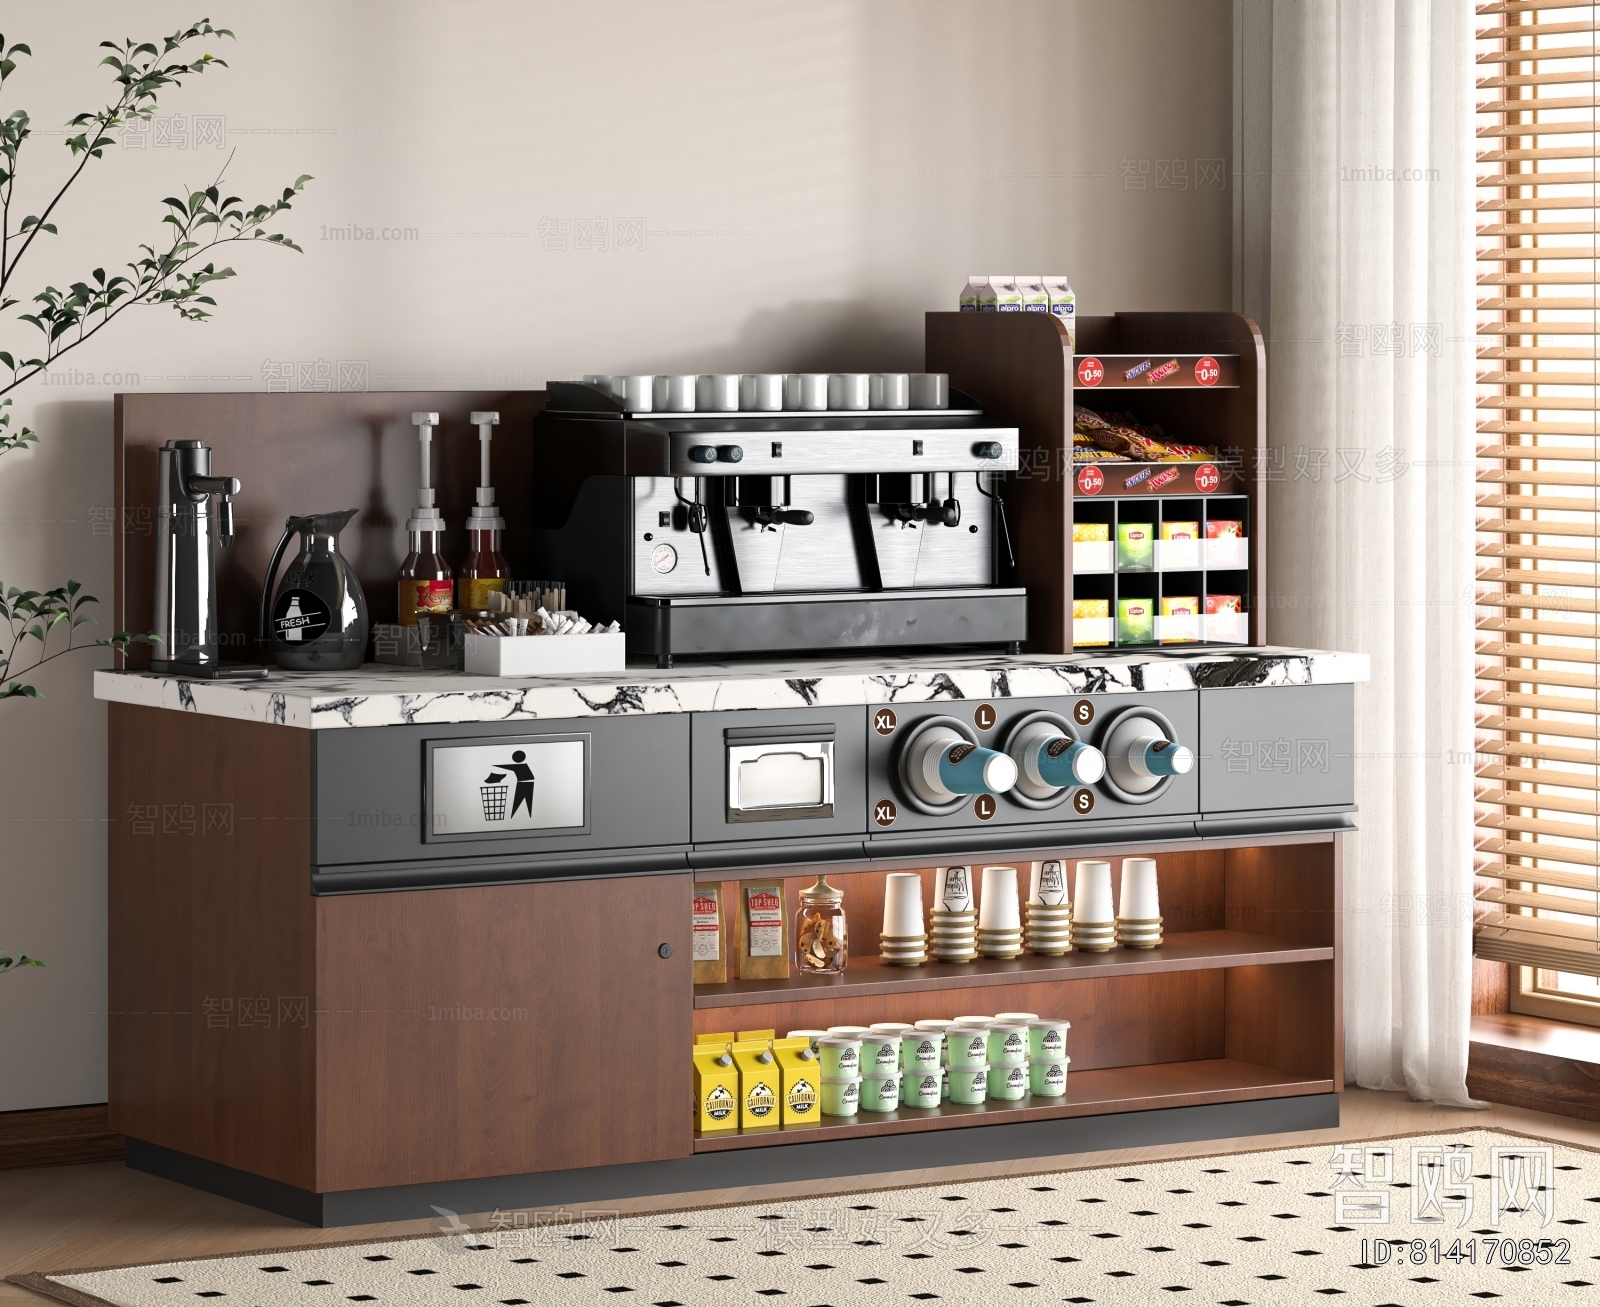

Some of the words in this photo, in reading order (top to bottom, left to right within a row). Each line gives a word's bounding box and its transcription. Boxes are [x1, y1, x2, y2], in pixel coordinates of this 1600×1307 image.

[1000, 304, 1019, 313] alpro
[1026, 304, 1045, 313] alpro
[1053, 304, 1072, 313] alpro
[280, 616, 311, 630] FRESH
[981, 710, 990, 724] L
[1079, 705, 1089, 719] S
[876, 715, 895, 730] XL
[1079, 794, 1089, 808] S
[876, 806, 895, 820] XL
[981, 800, 990, 815] L
[700, 902, 716, 912] SHED
[751, 898, 763, 907] TOP
[763, 898, 779, 907] SHED
[705, 1099, 734, 1110] CALIFORNIA
[747, 1096, 775, 1108] CALIFORNIA
[788, 1093, 816, 1104] CALIFORNIA
